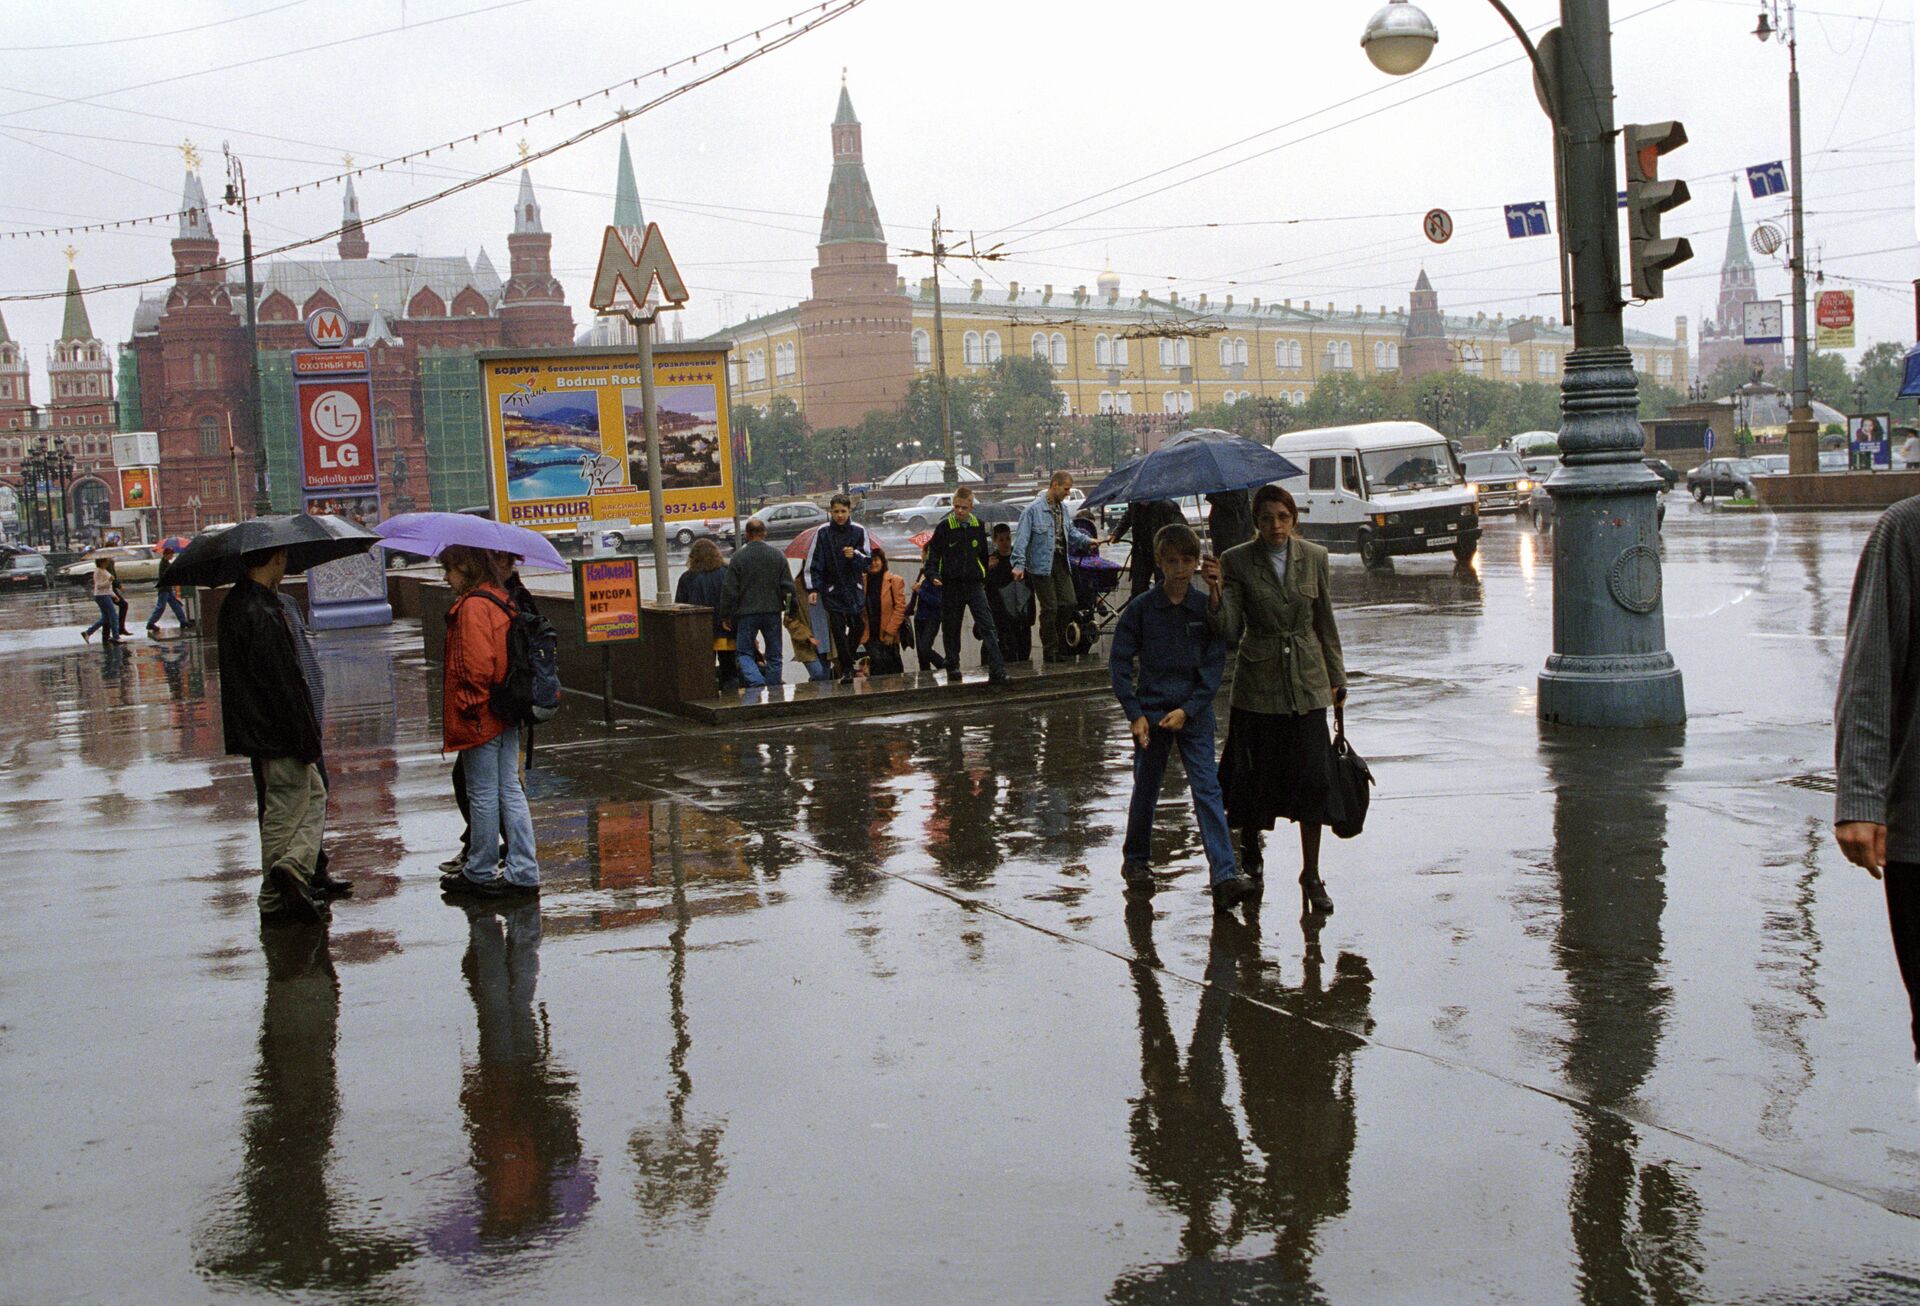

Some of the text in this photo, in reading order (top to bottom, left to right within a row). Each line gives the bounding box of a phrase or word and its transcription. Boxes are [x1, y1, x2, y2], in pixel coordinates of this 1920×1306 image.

[590, 222, 689, 310] М
[317, 314, 343, 339] М
[299, 361, 365, 370] ОХОТНЫЙ РЯД
[495, 365, 540, 375] БОДРУМ
[556, 376, 608, 388] Bodrum
[319, 443, 360, 468] LG
[308, 473, 375, 485] Digitally yours
[511, 501, 590, 519] BENTOUR
[664, 500, 726, 514] 937-16-44
[590, 588, 632, 600] МУСОРА
[590, 602, 608, 613] НЕТ
